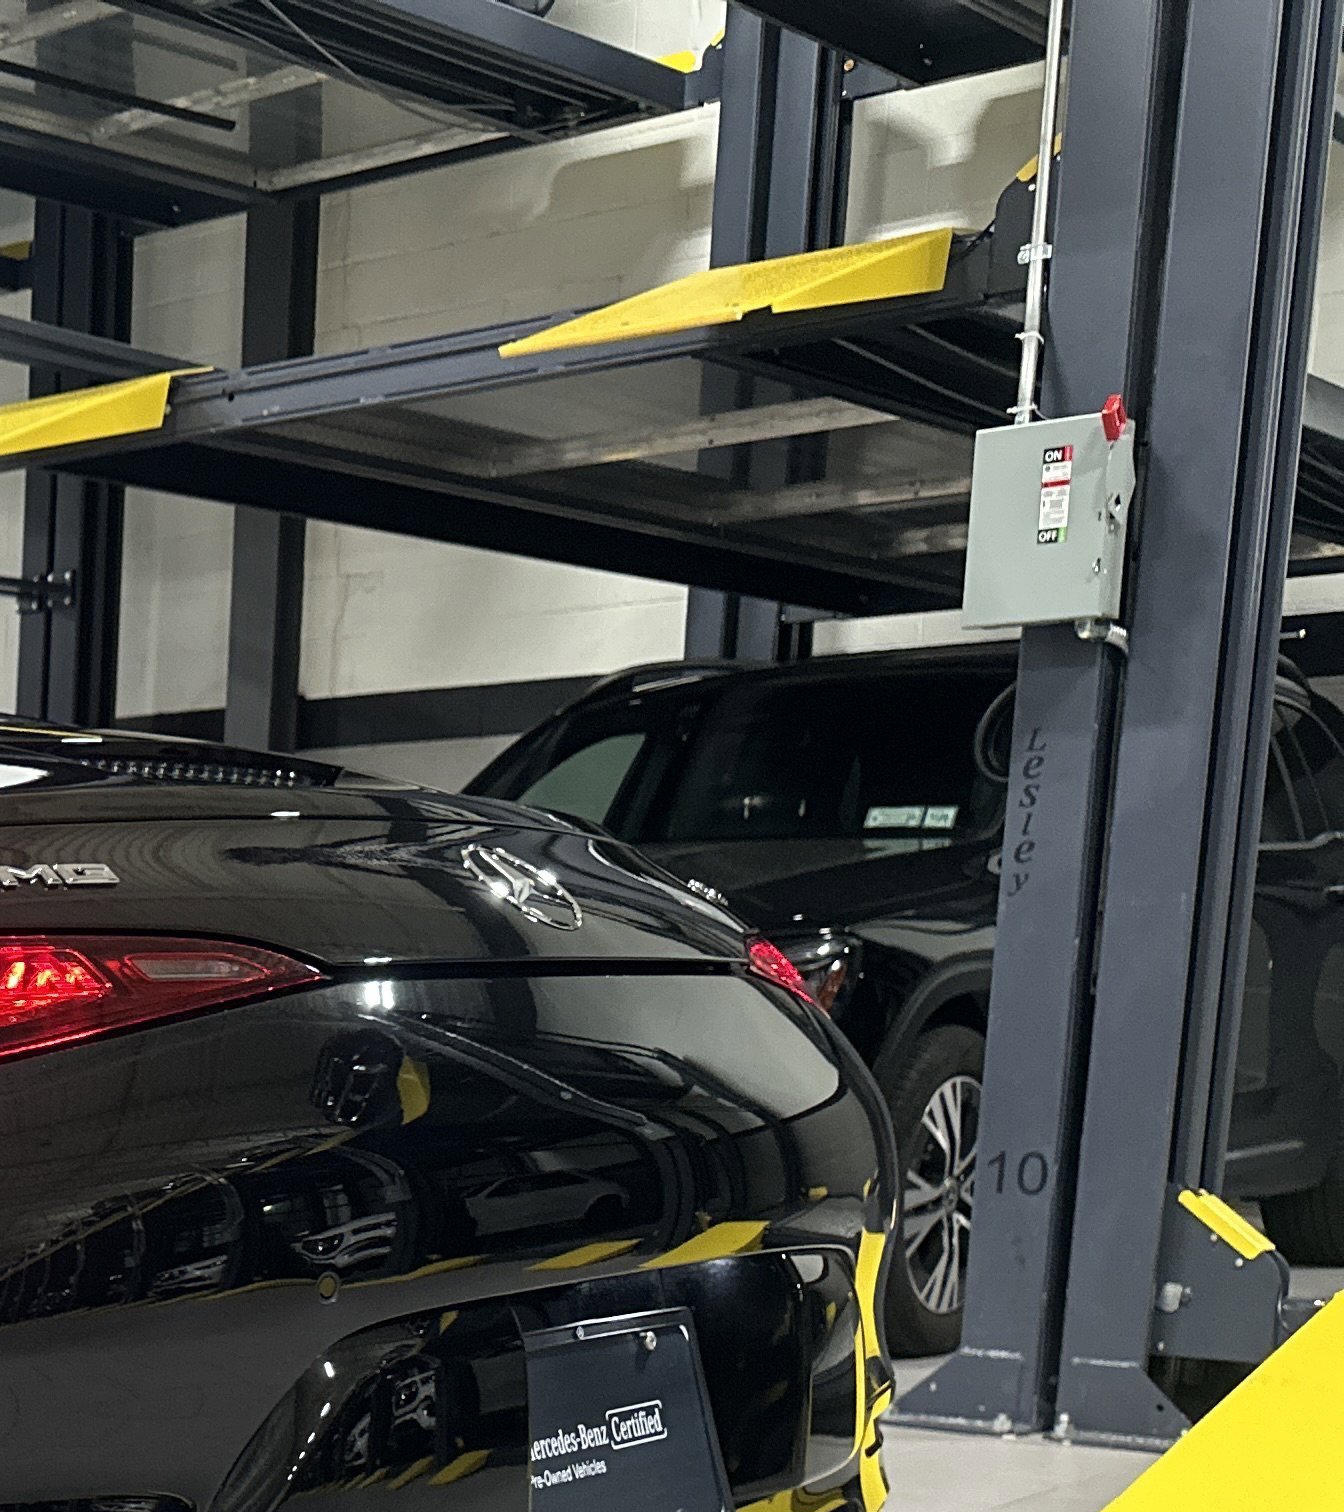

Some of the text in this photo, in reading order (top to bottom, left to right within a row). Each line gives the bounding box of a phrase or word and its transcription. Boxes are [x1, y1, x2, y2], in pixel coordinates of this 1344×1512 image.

[1044, 449, 1063, 462] ON
[1038, 529, 1058, 543] OFF
[1007, 726, 1048, 897] Lesley
[987, 1150, 1048, 1196] 10
[610, 1407, 664, 1442] Certified
[572, 1459, 607, 1479] Vehicles
